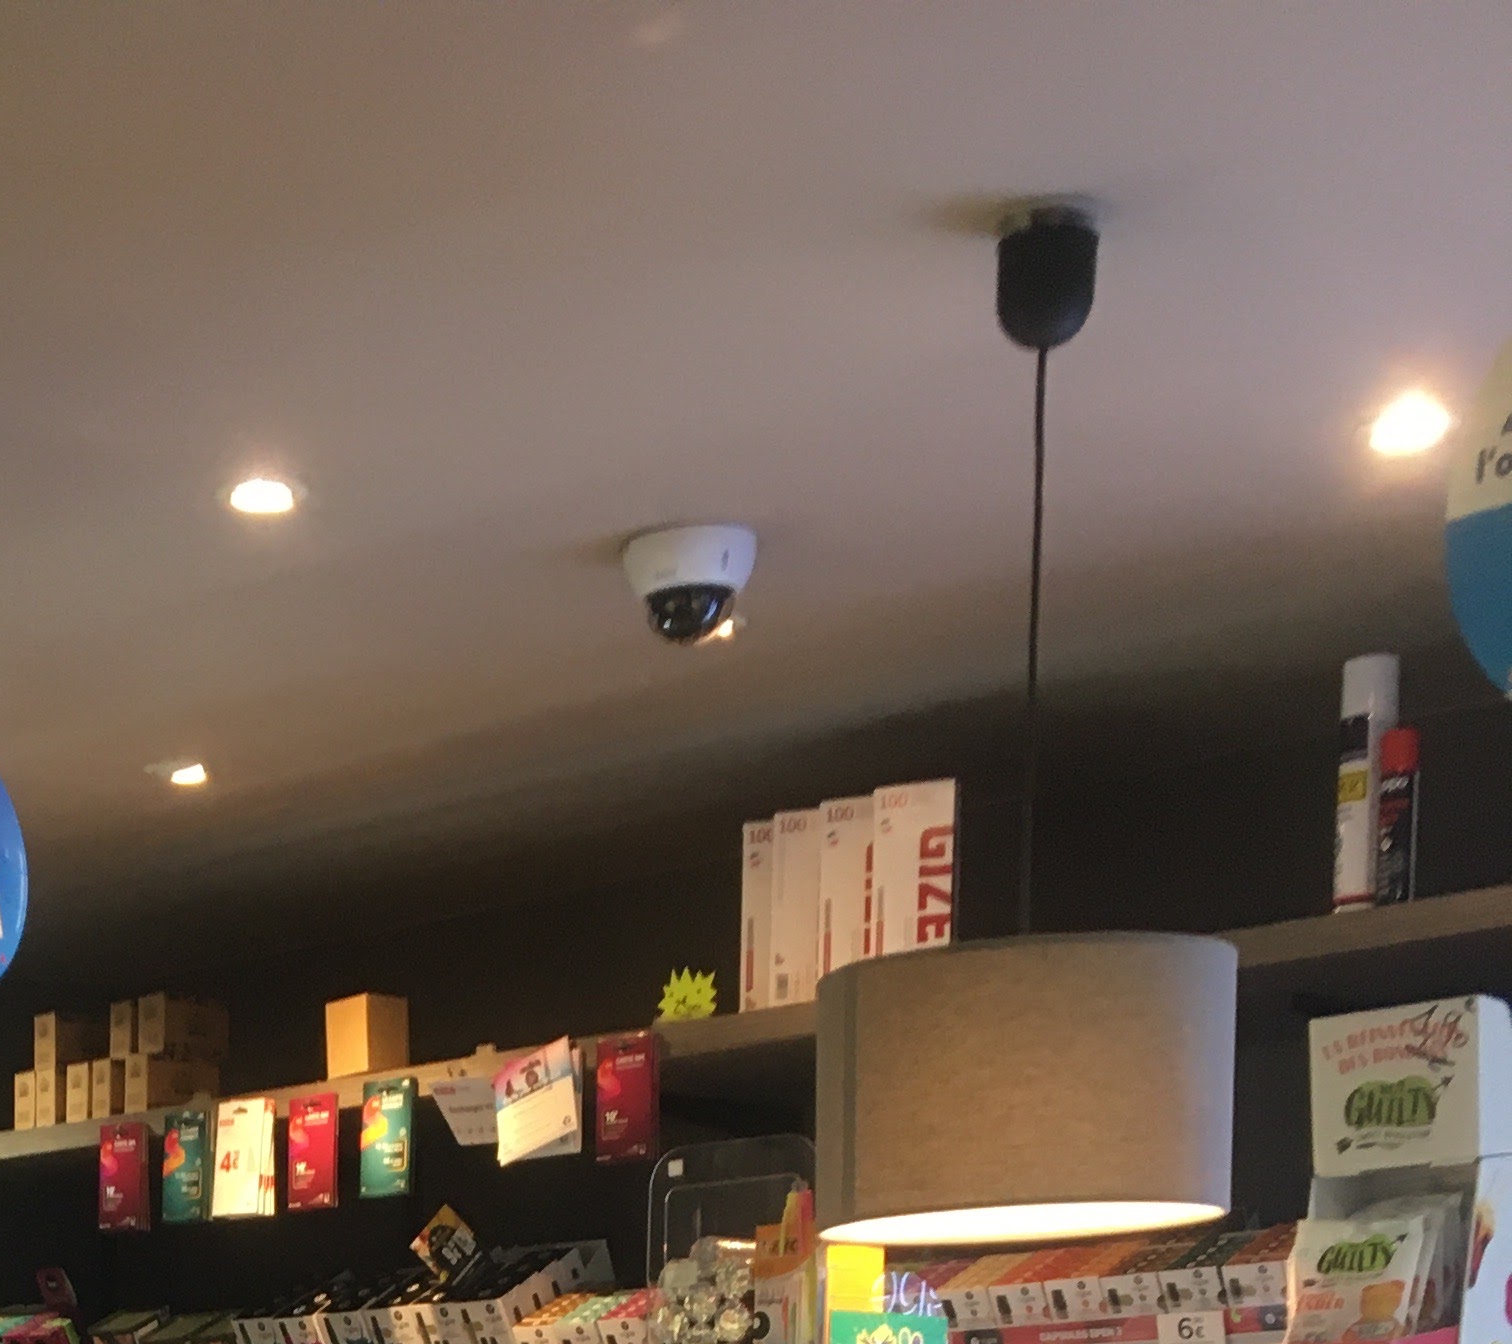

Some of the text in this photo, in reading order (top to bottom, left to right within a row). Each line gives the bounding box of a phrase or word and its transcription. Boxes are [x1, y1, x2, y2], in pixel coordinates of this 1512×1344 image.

[881, 793, 908, 809] 100
[827, 807, 854, 823] 100
[780, 817, 807, 833] 100
[1344, 1086, 1438, 1128] GUILTY
[1317, 1243, 1391, 1273] GUILTY
